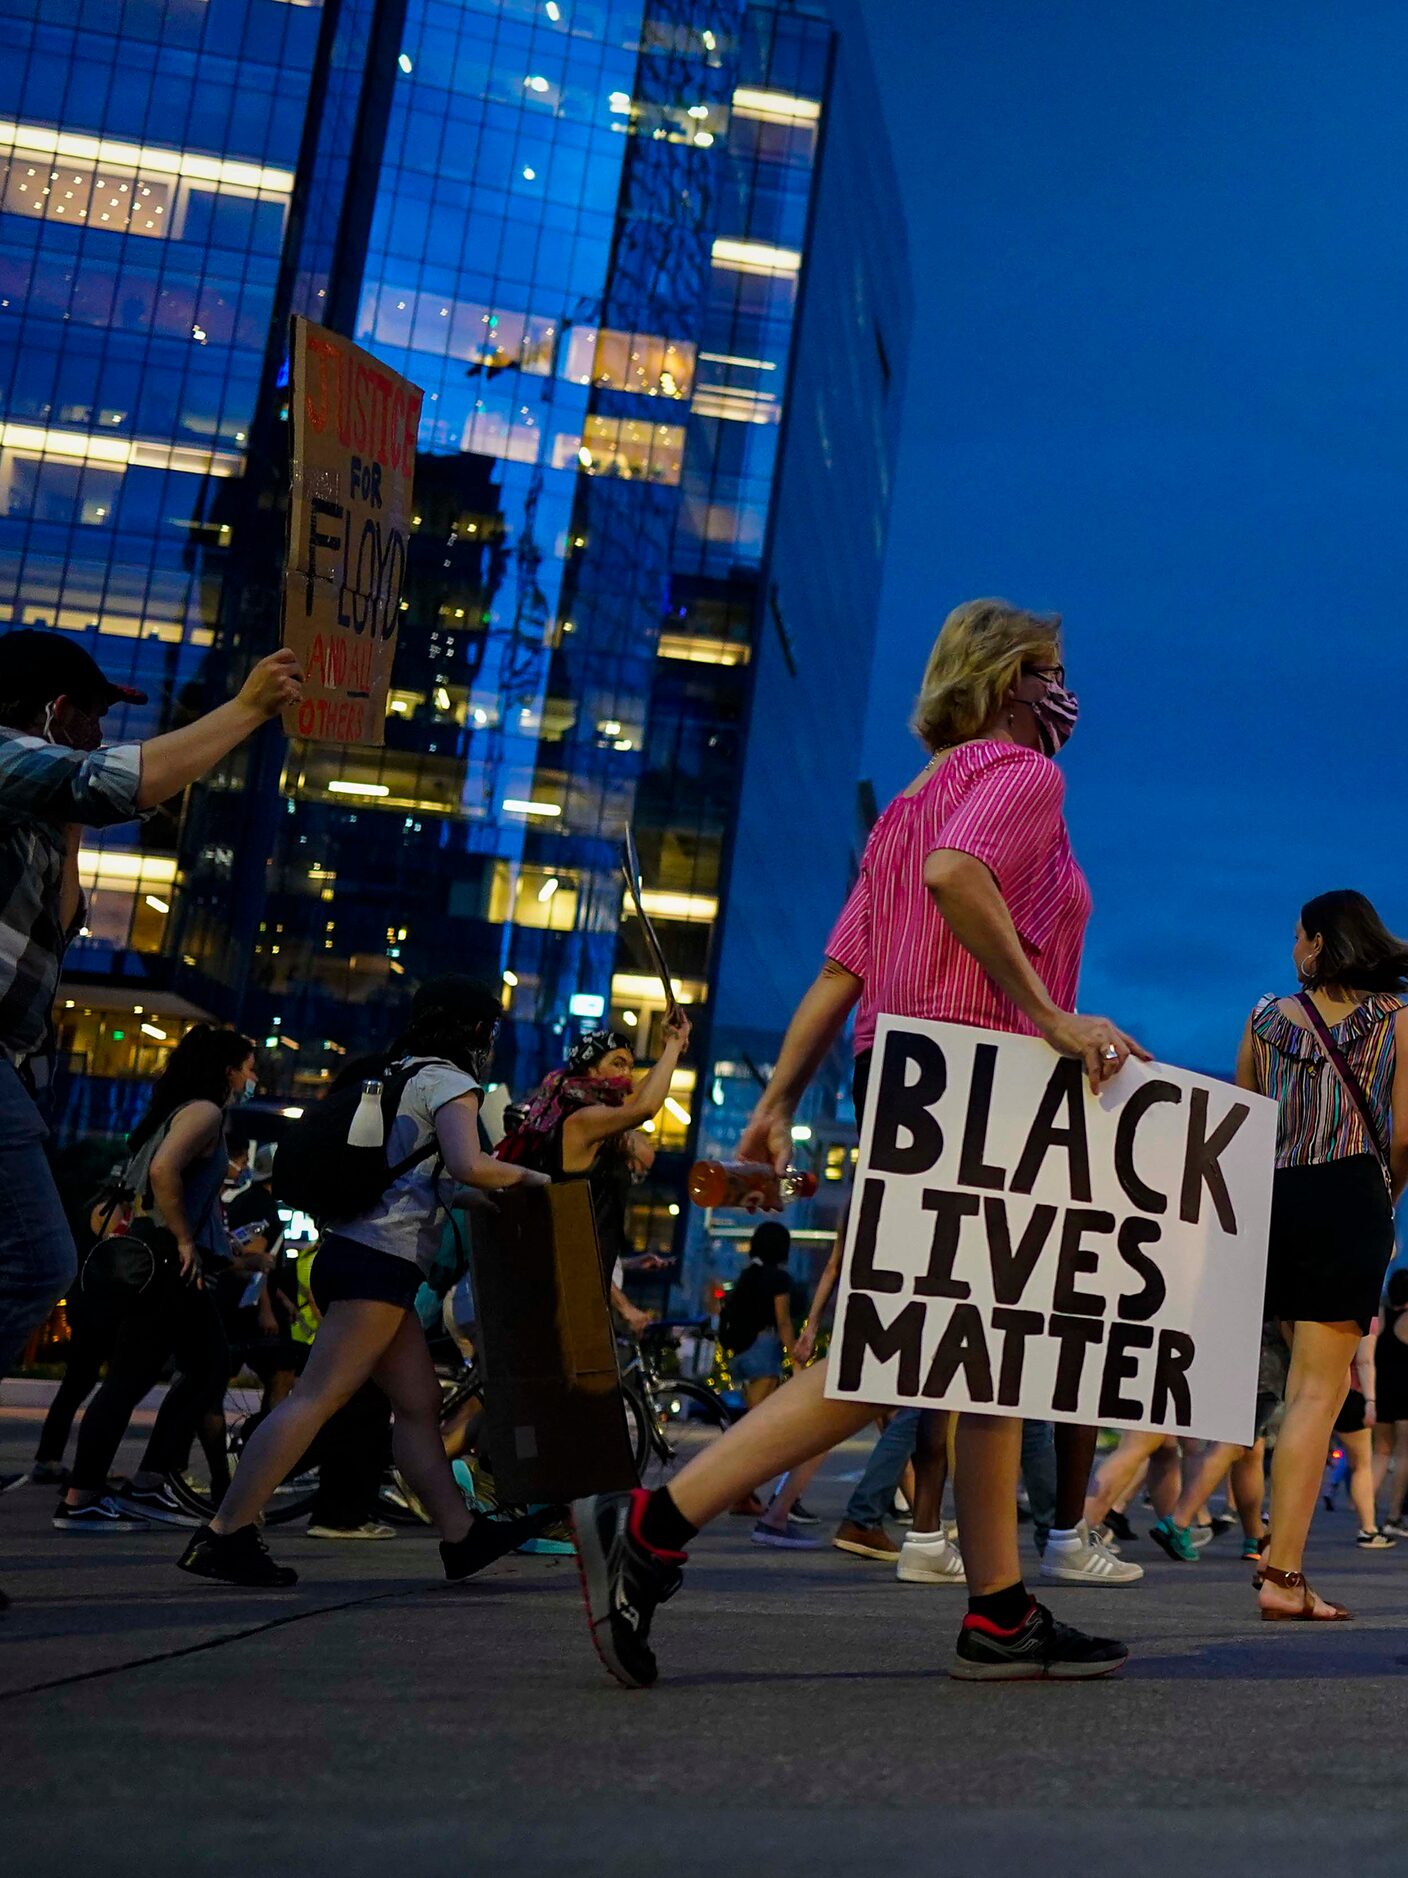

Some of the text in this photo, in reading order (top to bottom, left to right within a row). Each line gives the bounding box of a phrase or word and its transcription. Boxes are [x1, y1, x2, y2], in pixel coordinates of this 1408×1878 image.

[306, 335, 419, 479] JUSTICE
[350, 455, 383, 509] FOR
[306, 497, 407, 641] FLOYD
[297, 697, 366, 742] OTHERS
[305, 632, 347, 686] AND
[869, 1030, 1250, 1235] BLACK
[850, 1178, 1167, 1321] LIVES
[837, 1292, 1195, 1427] MATTER
